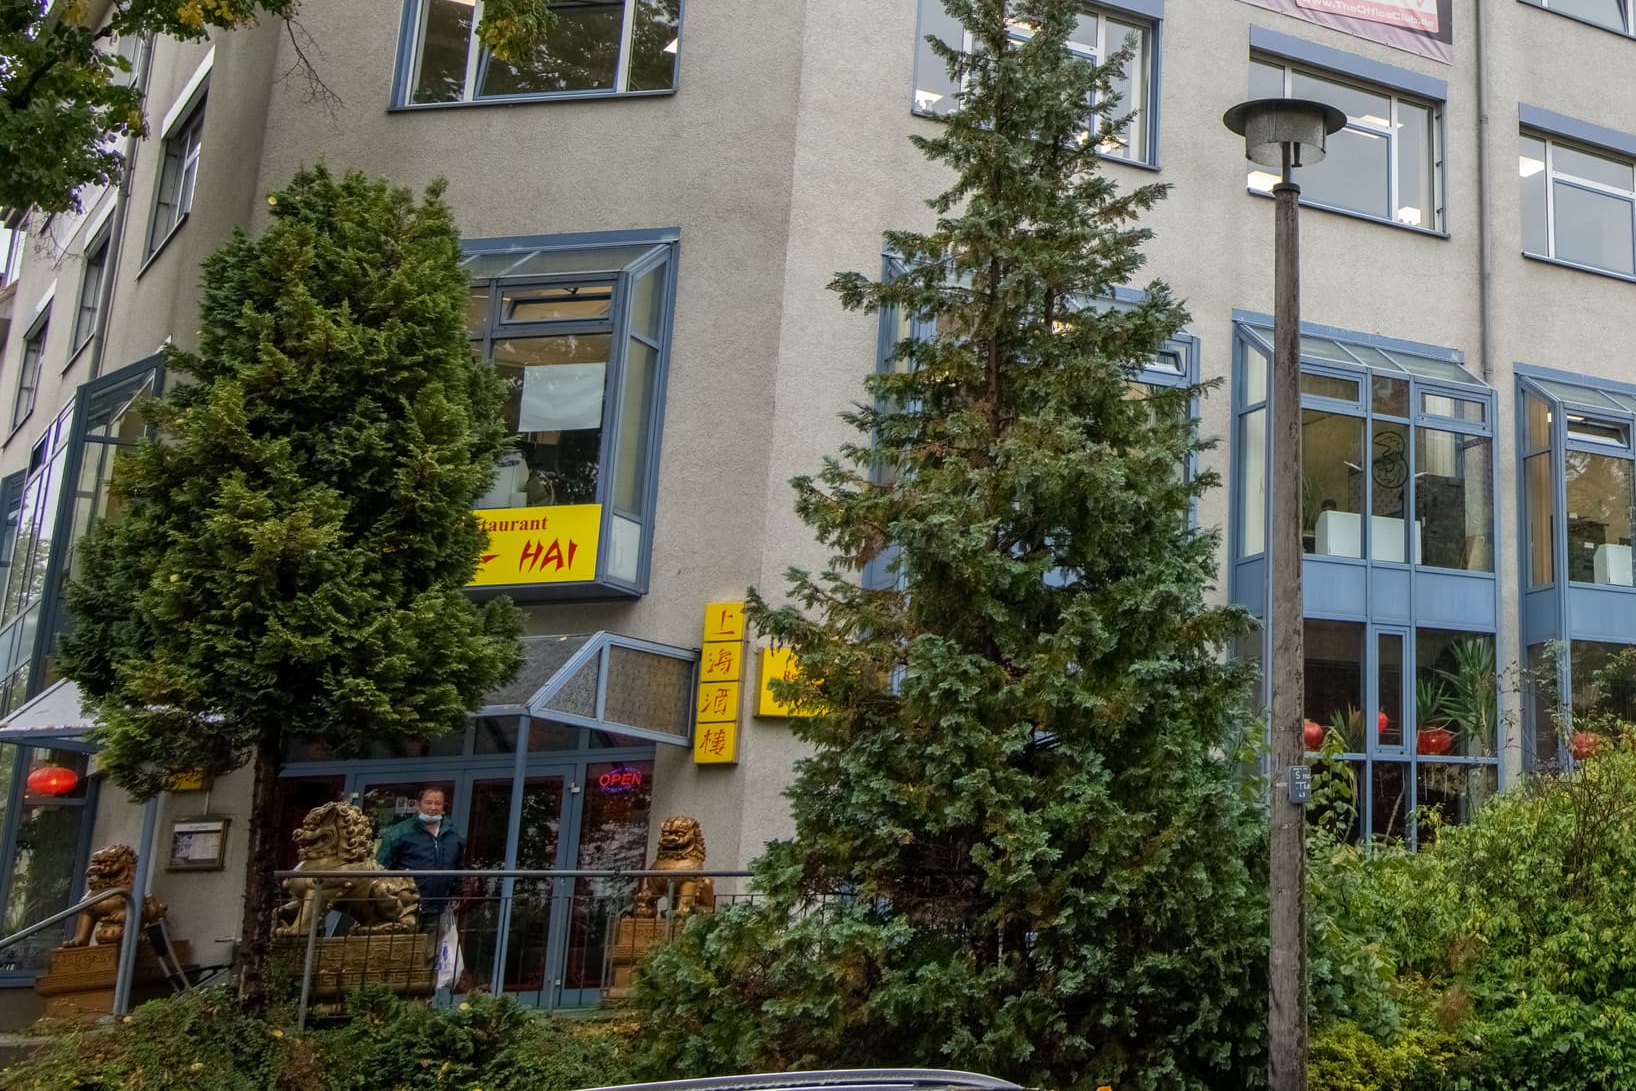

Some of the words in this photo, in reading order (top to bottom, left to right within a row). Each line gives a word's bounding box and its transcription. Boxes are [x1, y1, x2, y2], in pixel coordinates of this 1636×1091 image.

[479, 516, 548, 532] taurant
[518, 538, 577, 574] HAI
[599, 773, 641, 787] OPEN
